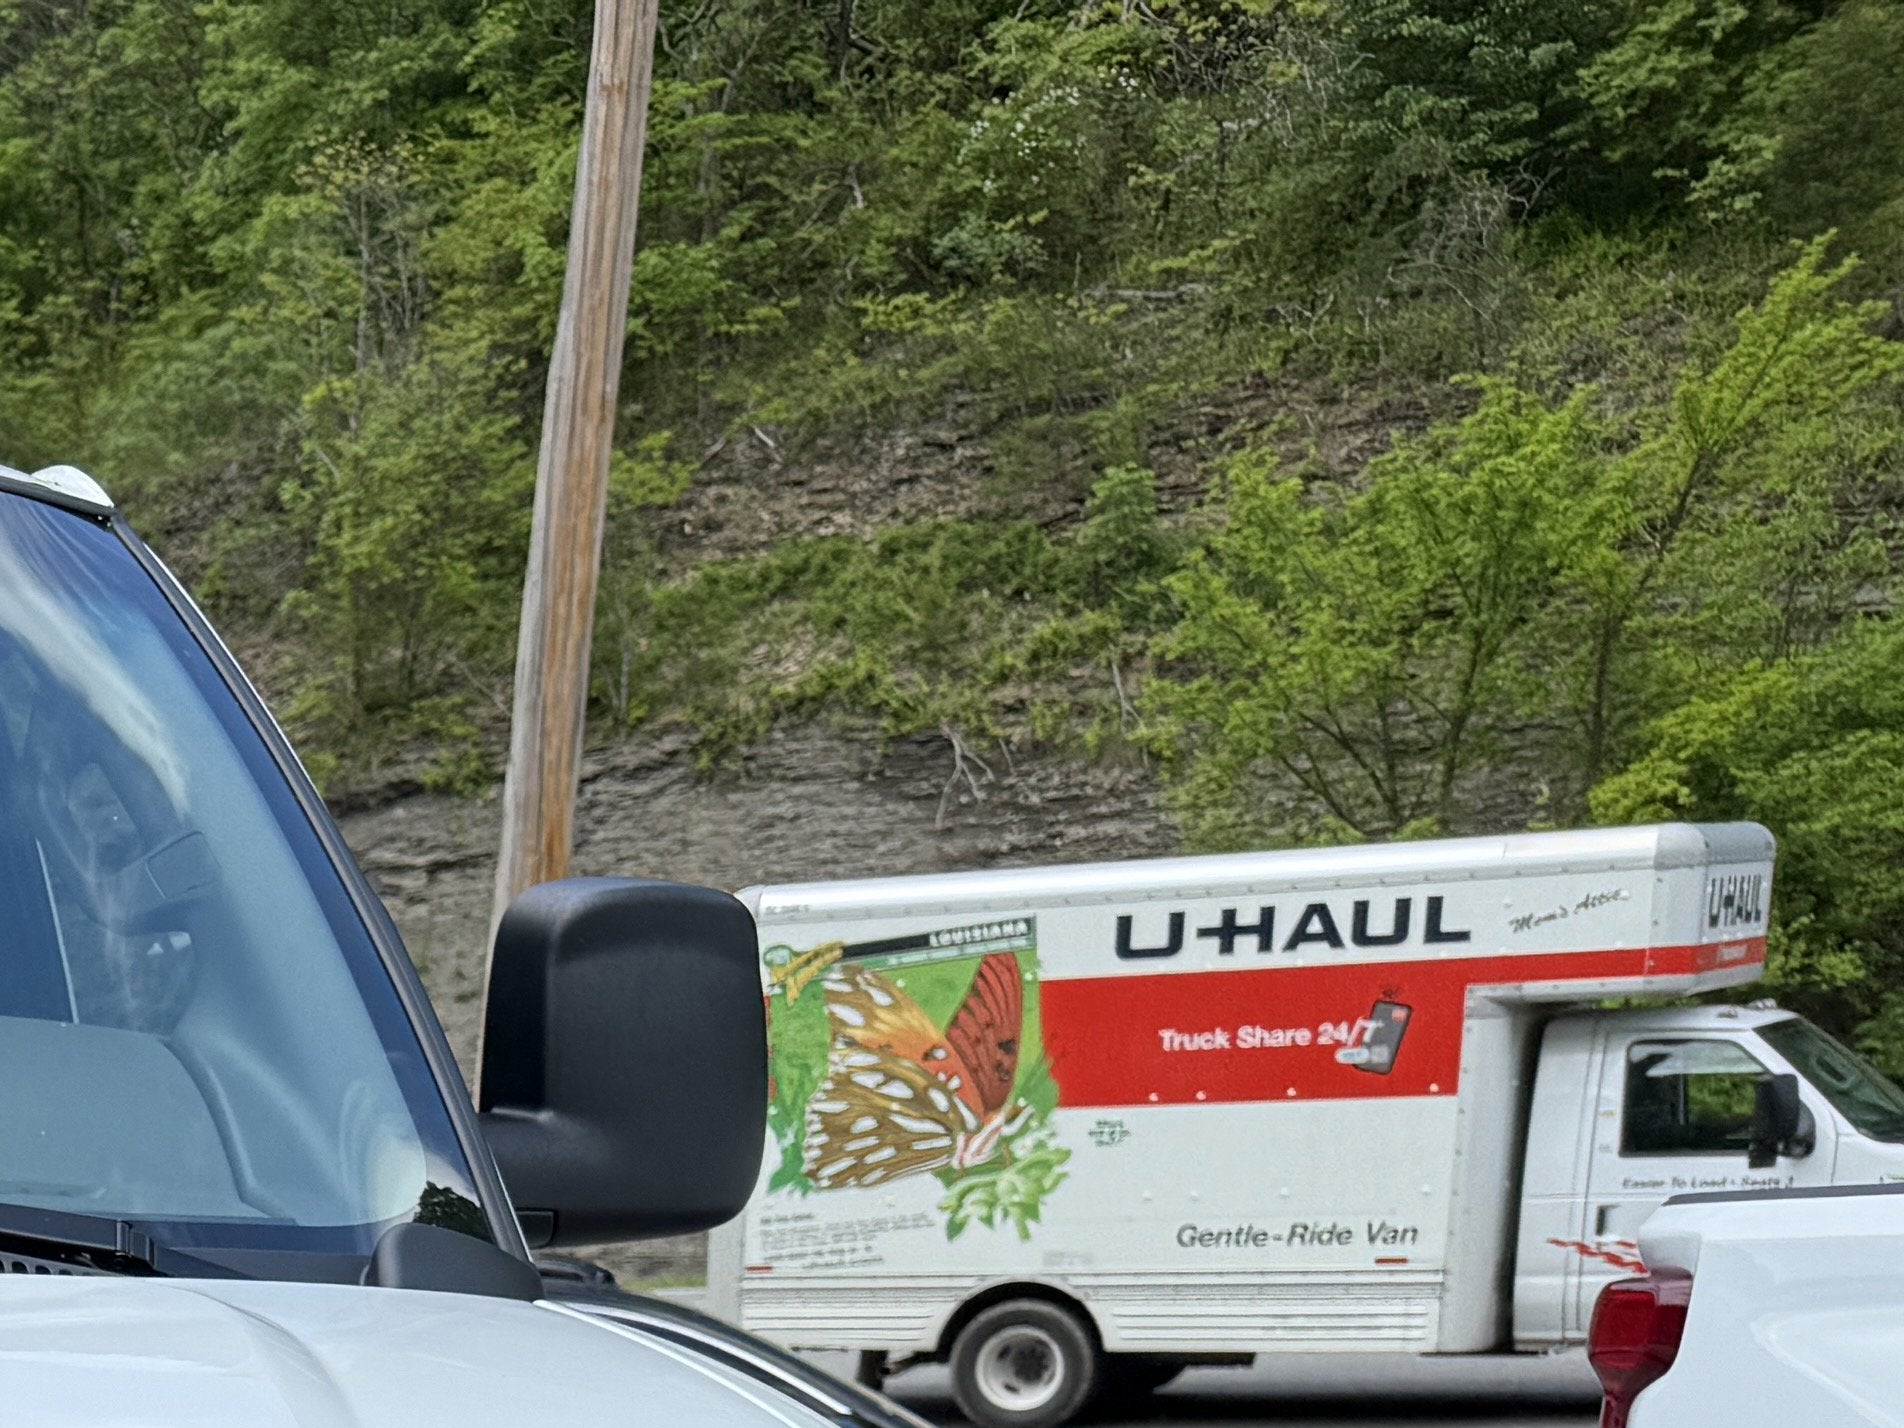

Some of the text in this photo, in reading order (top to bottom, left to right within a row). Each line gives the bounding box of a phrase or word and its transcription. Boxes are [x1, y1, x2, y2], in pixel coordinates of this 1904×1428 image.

[929, 919, 1029, 948] LOUISIANA
[1115, 896, 1471, 959] U-HAUL
[1158, 1027, 1231, 1052] Truck
[1236, 1025, 1312, 1049] Share
[1176, 1220, 1420, 1248] Gentle-Ride Van
